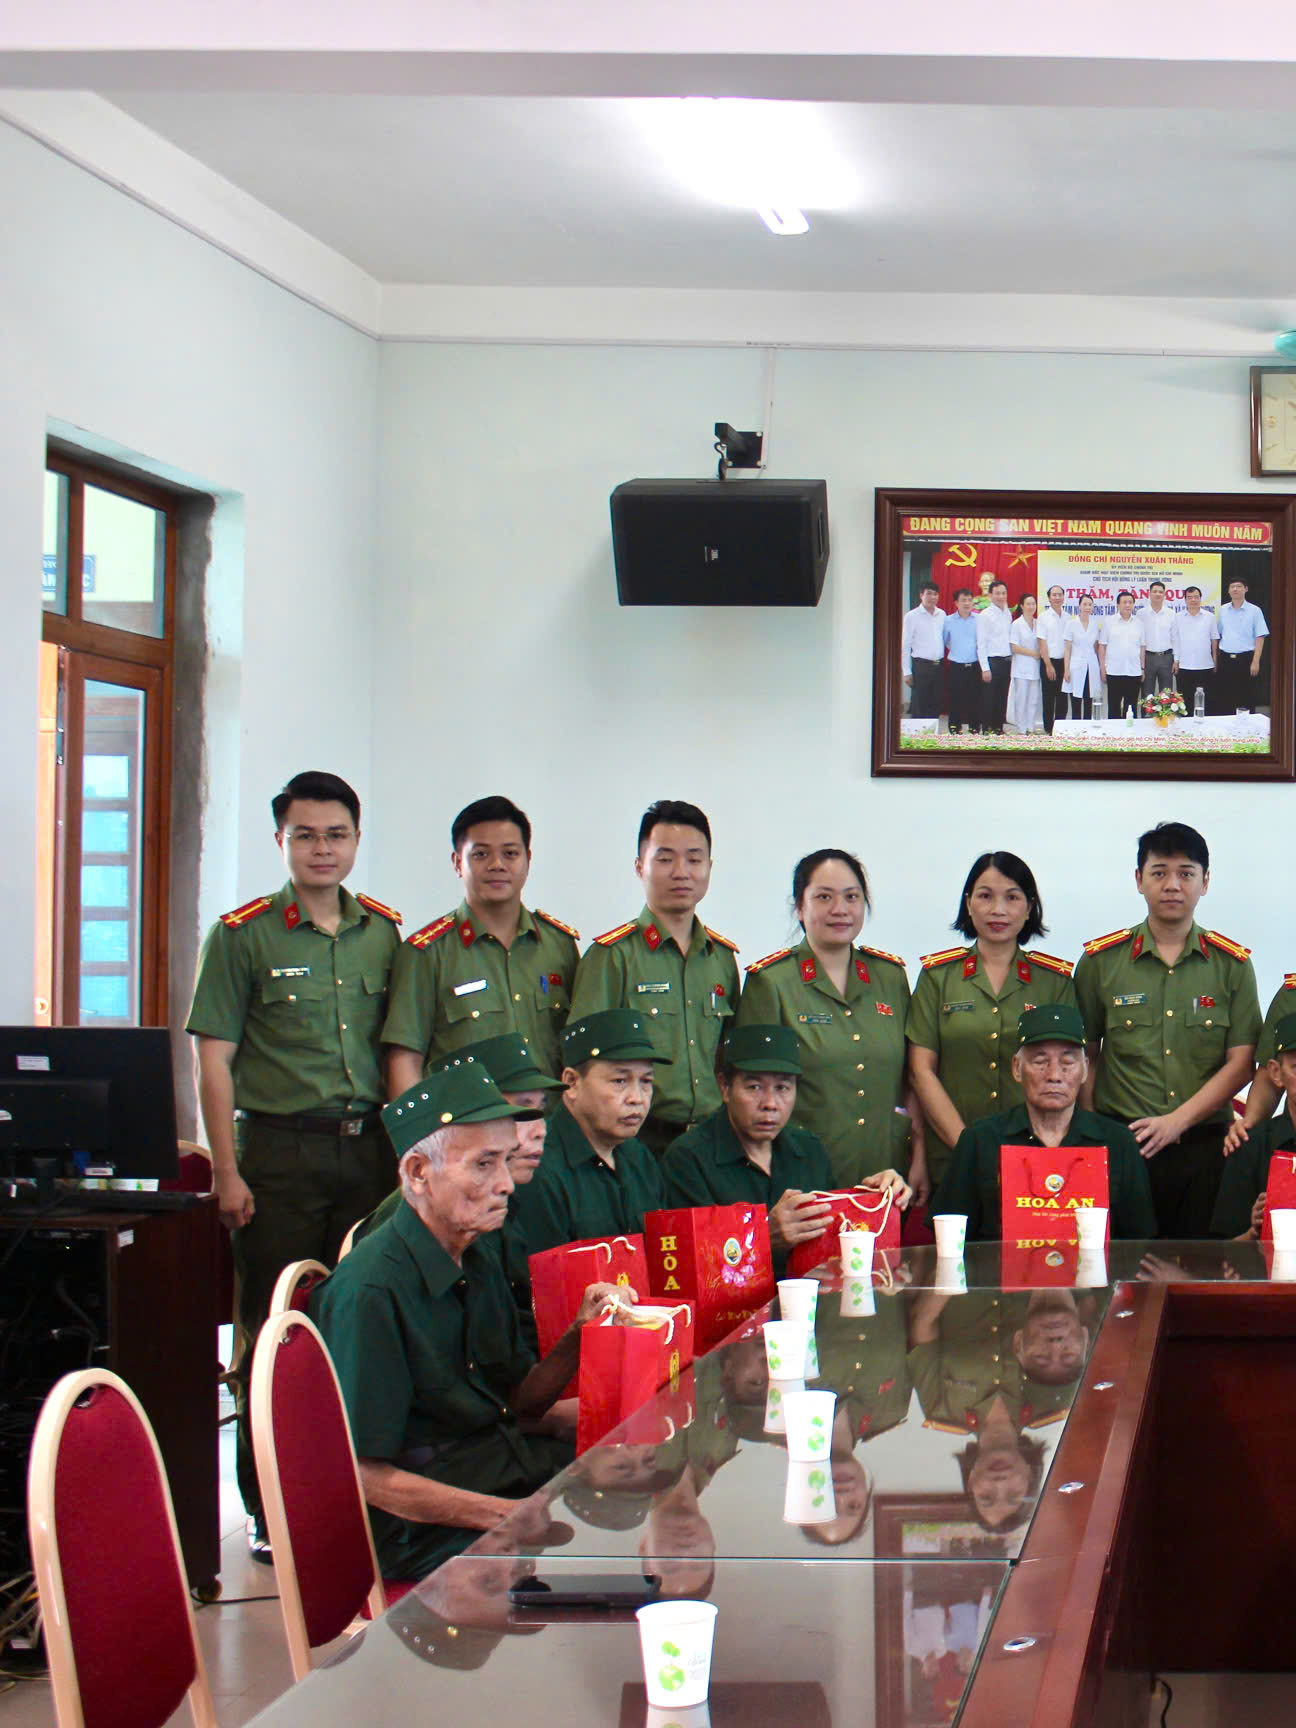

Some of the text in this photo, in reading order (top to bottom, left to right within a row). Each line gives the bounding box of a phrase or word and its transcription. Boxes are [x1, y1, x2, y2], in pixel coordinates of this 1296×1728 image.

[1068, 520, 1101, 534] NAM
[1105, 521, 1152, 535] QUANG
[1065, 1197, 1095, 1209] AN
